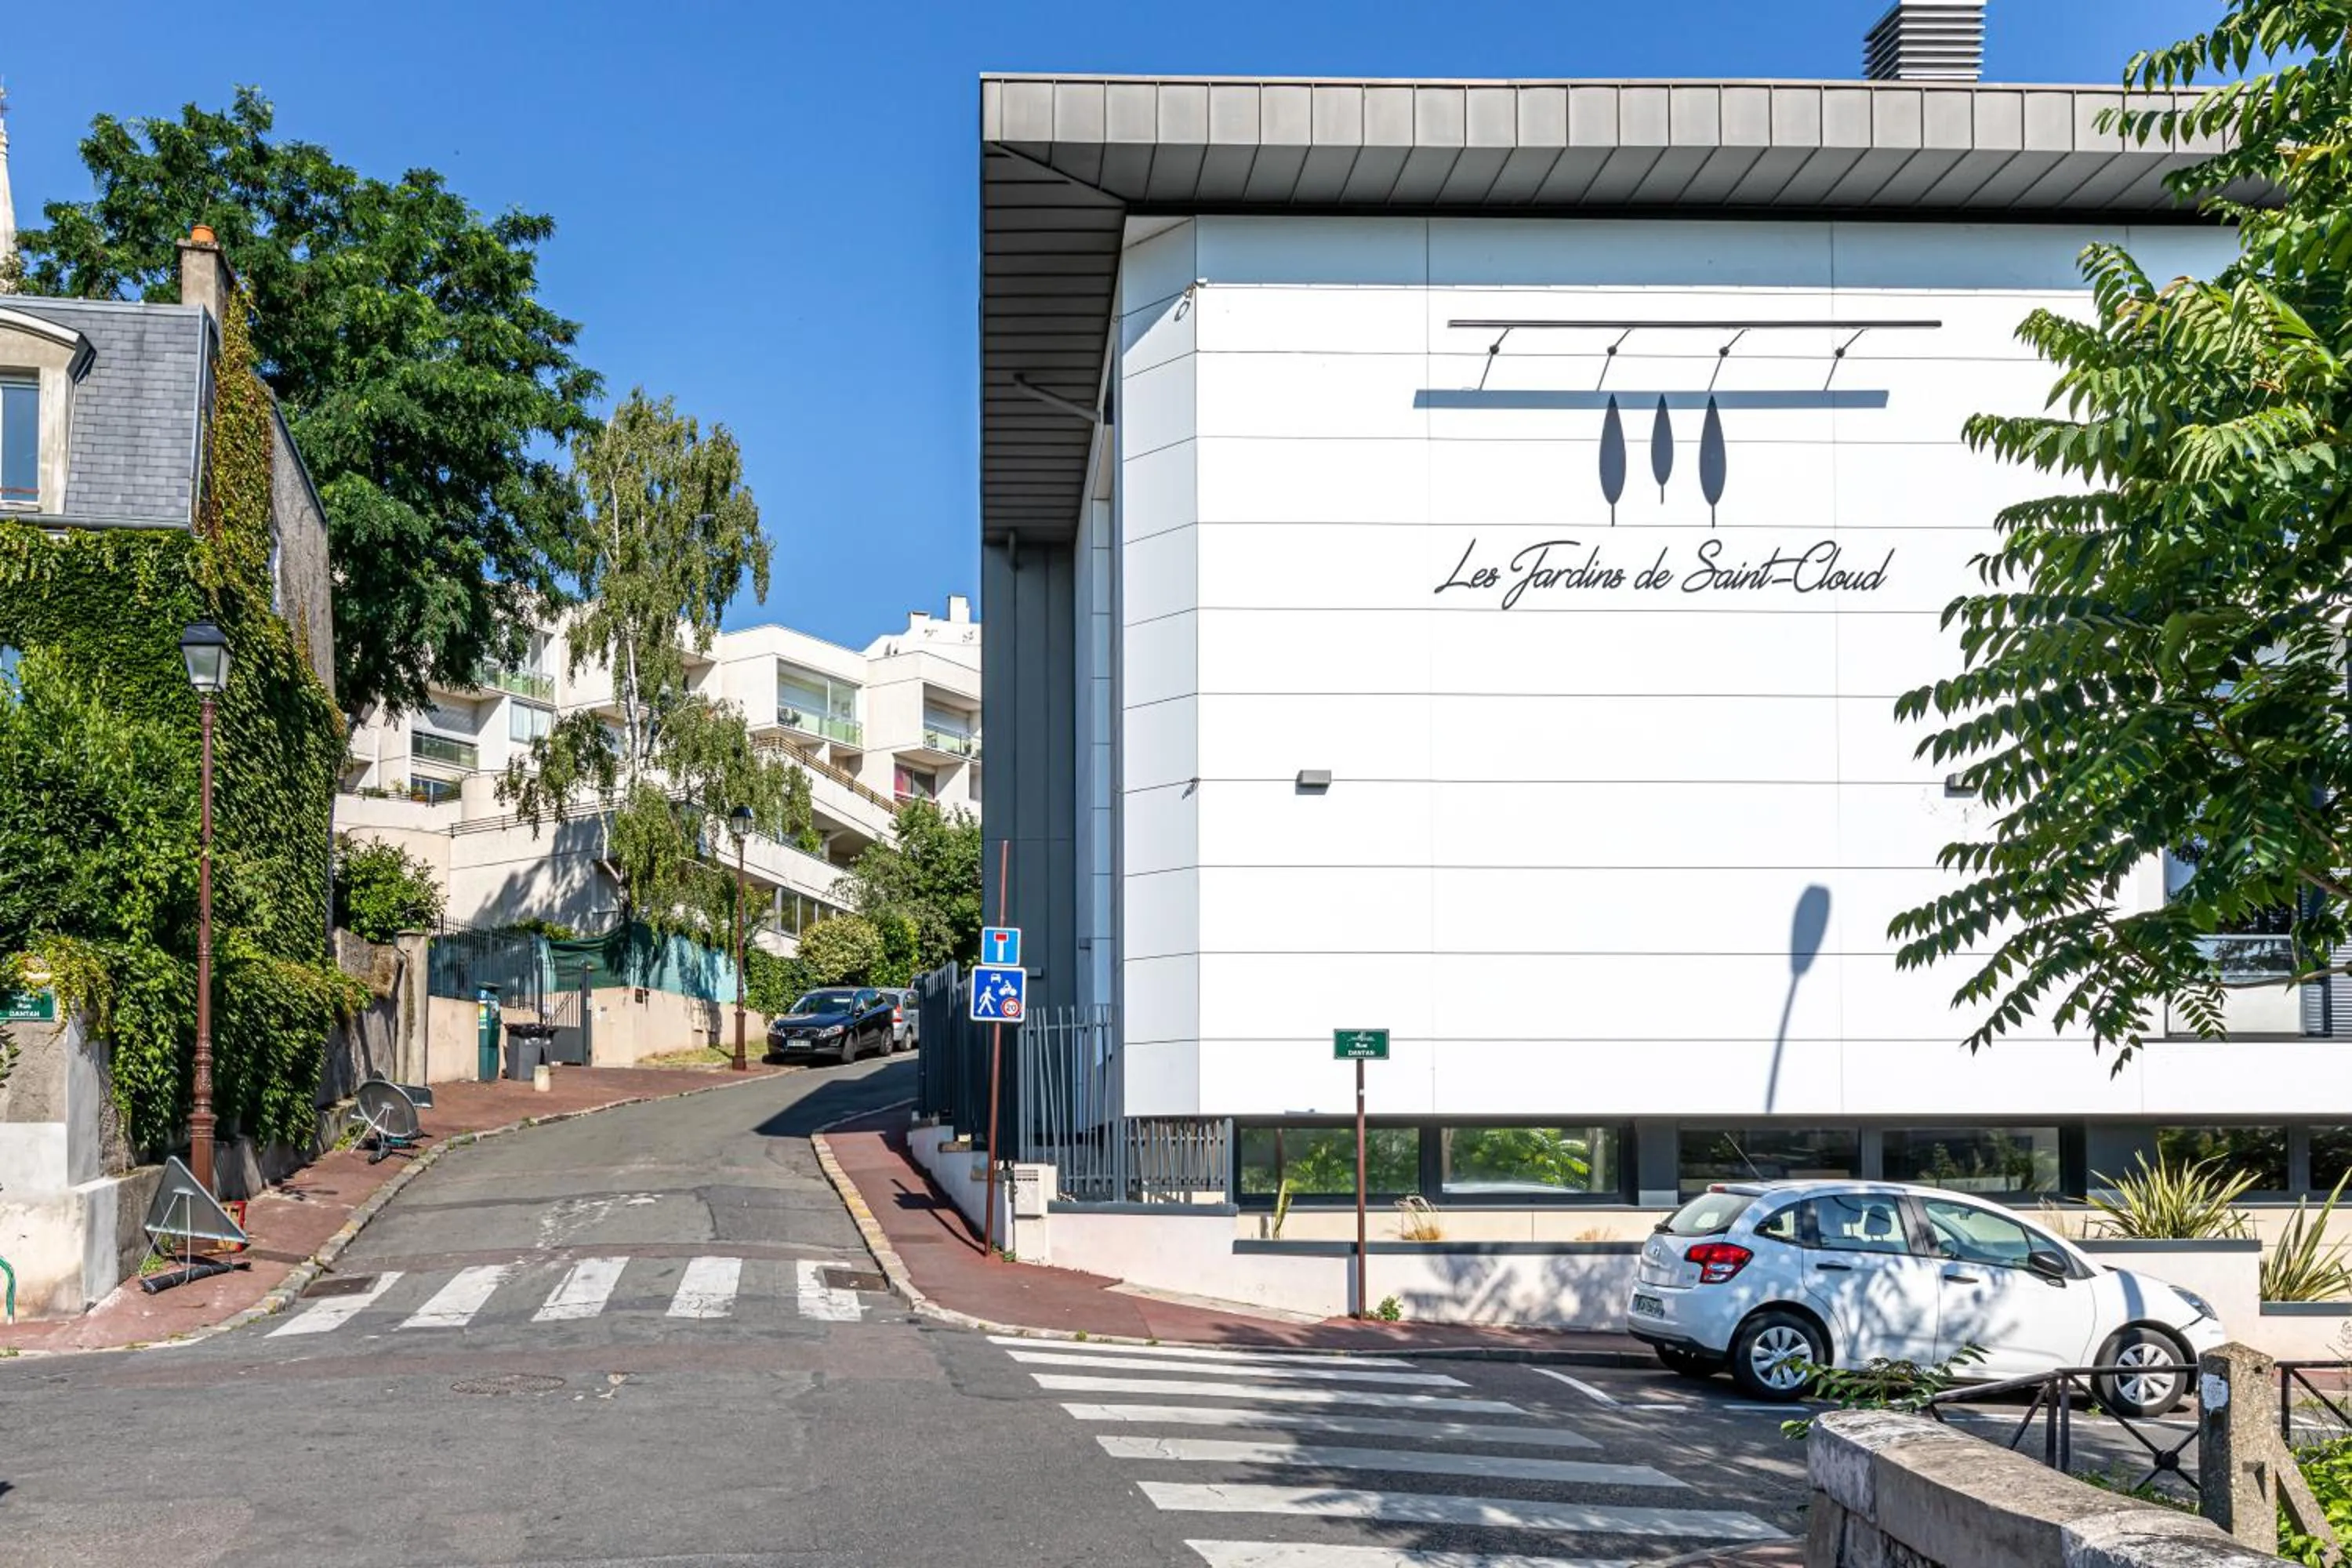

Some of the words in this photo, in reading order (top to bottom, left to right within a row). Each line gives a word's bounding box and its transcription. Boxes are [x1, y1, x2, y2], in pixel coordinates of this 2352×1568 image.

[1434, 539, 1500, 593] Les
[1501, 540, 1627, 610] Jardins
[1634, 546, 1674, 590] de
[1681, 539, 1896, 593] Saint-Cloud
